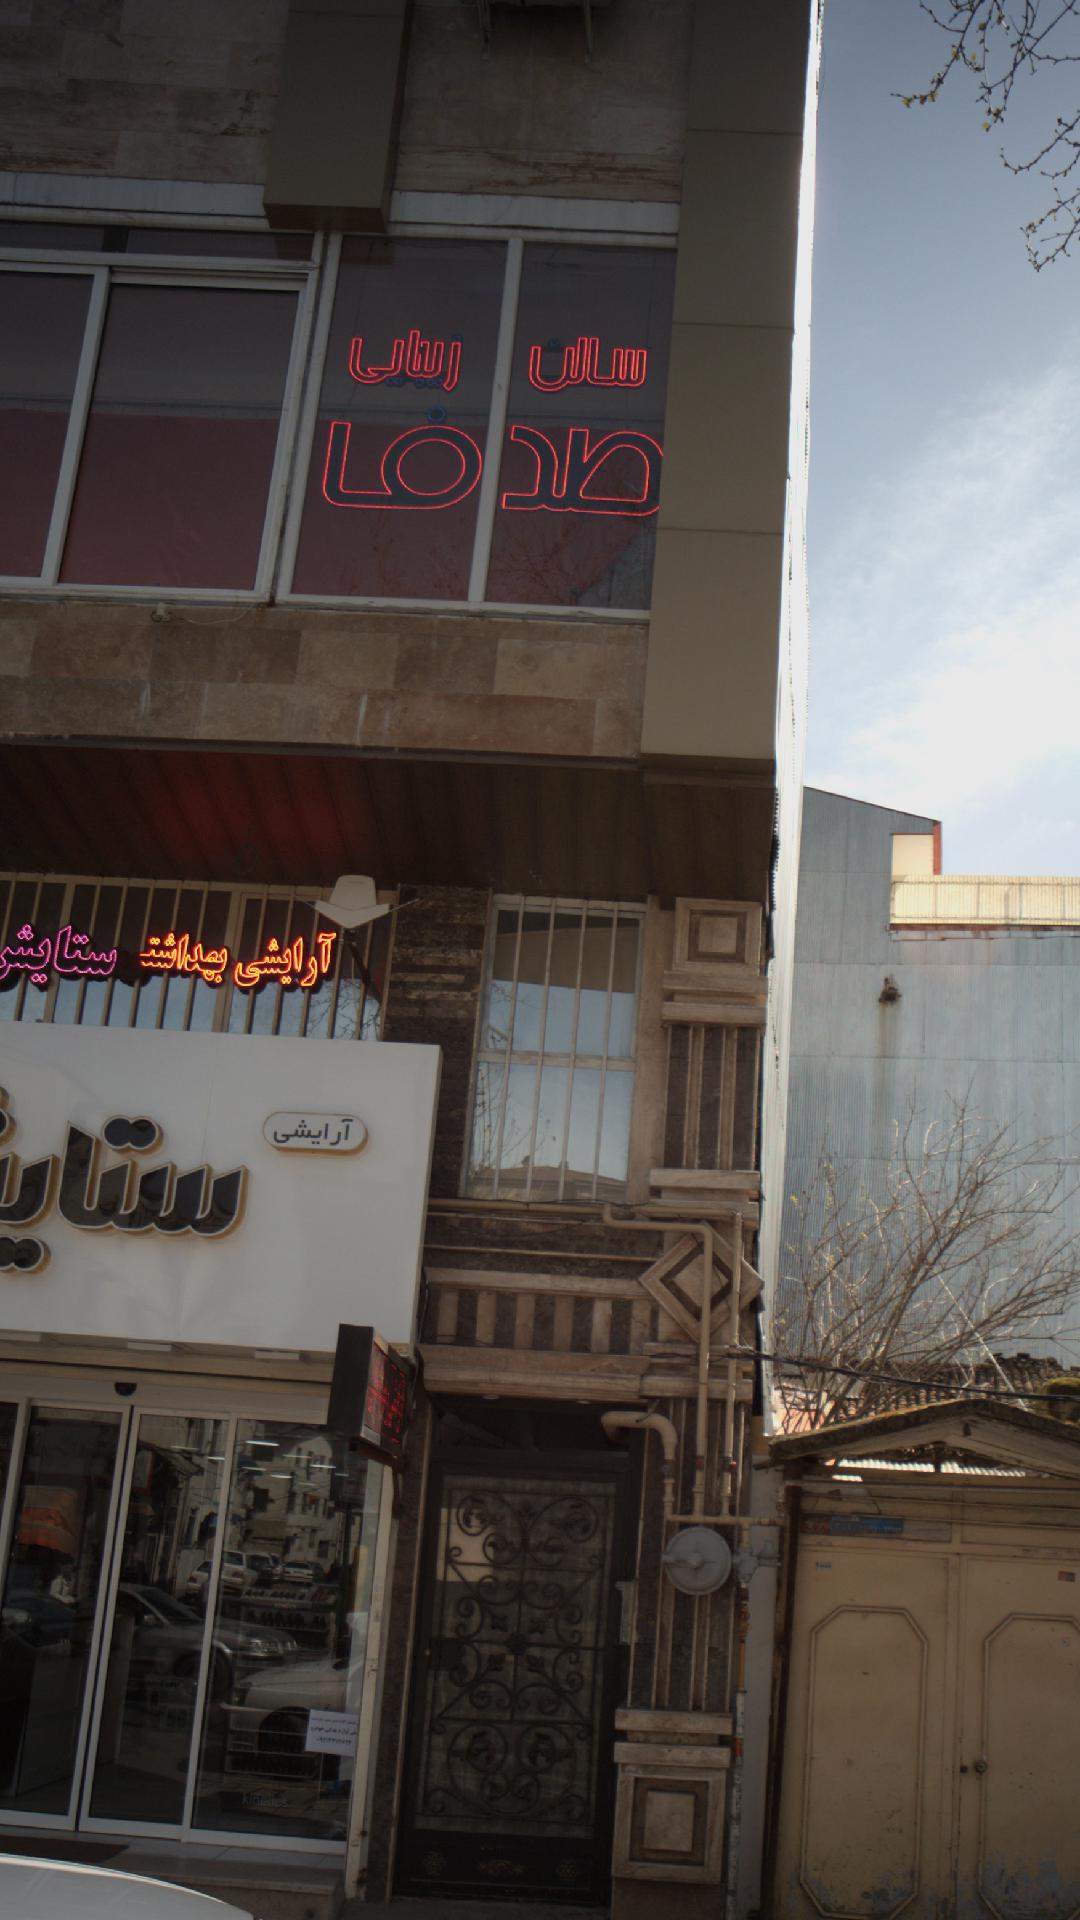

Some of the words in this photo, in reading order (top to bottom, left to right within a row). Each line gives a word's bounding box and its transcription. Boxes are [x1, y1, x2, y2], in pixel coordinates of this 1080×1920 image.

[348, 329, 464, 392] زیبایی
[528, 336, 648, 392] سالن
[234, 931, 338, 987] آرایشی
[272, 1117, 355, 1147] آرایشی
[0, 1086, 250, 1274] ستای
